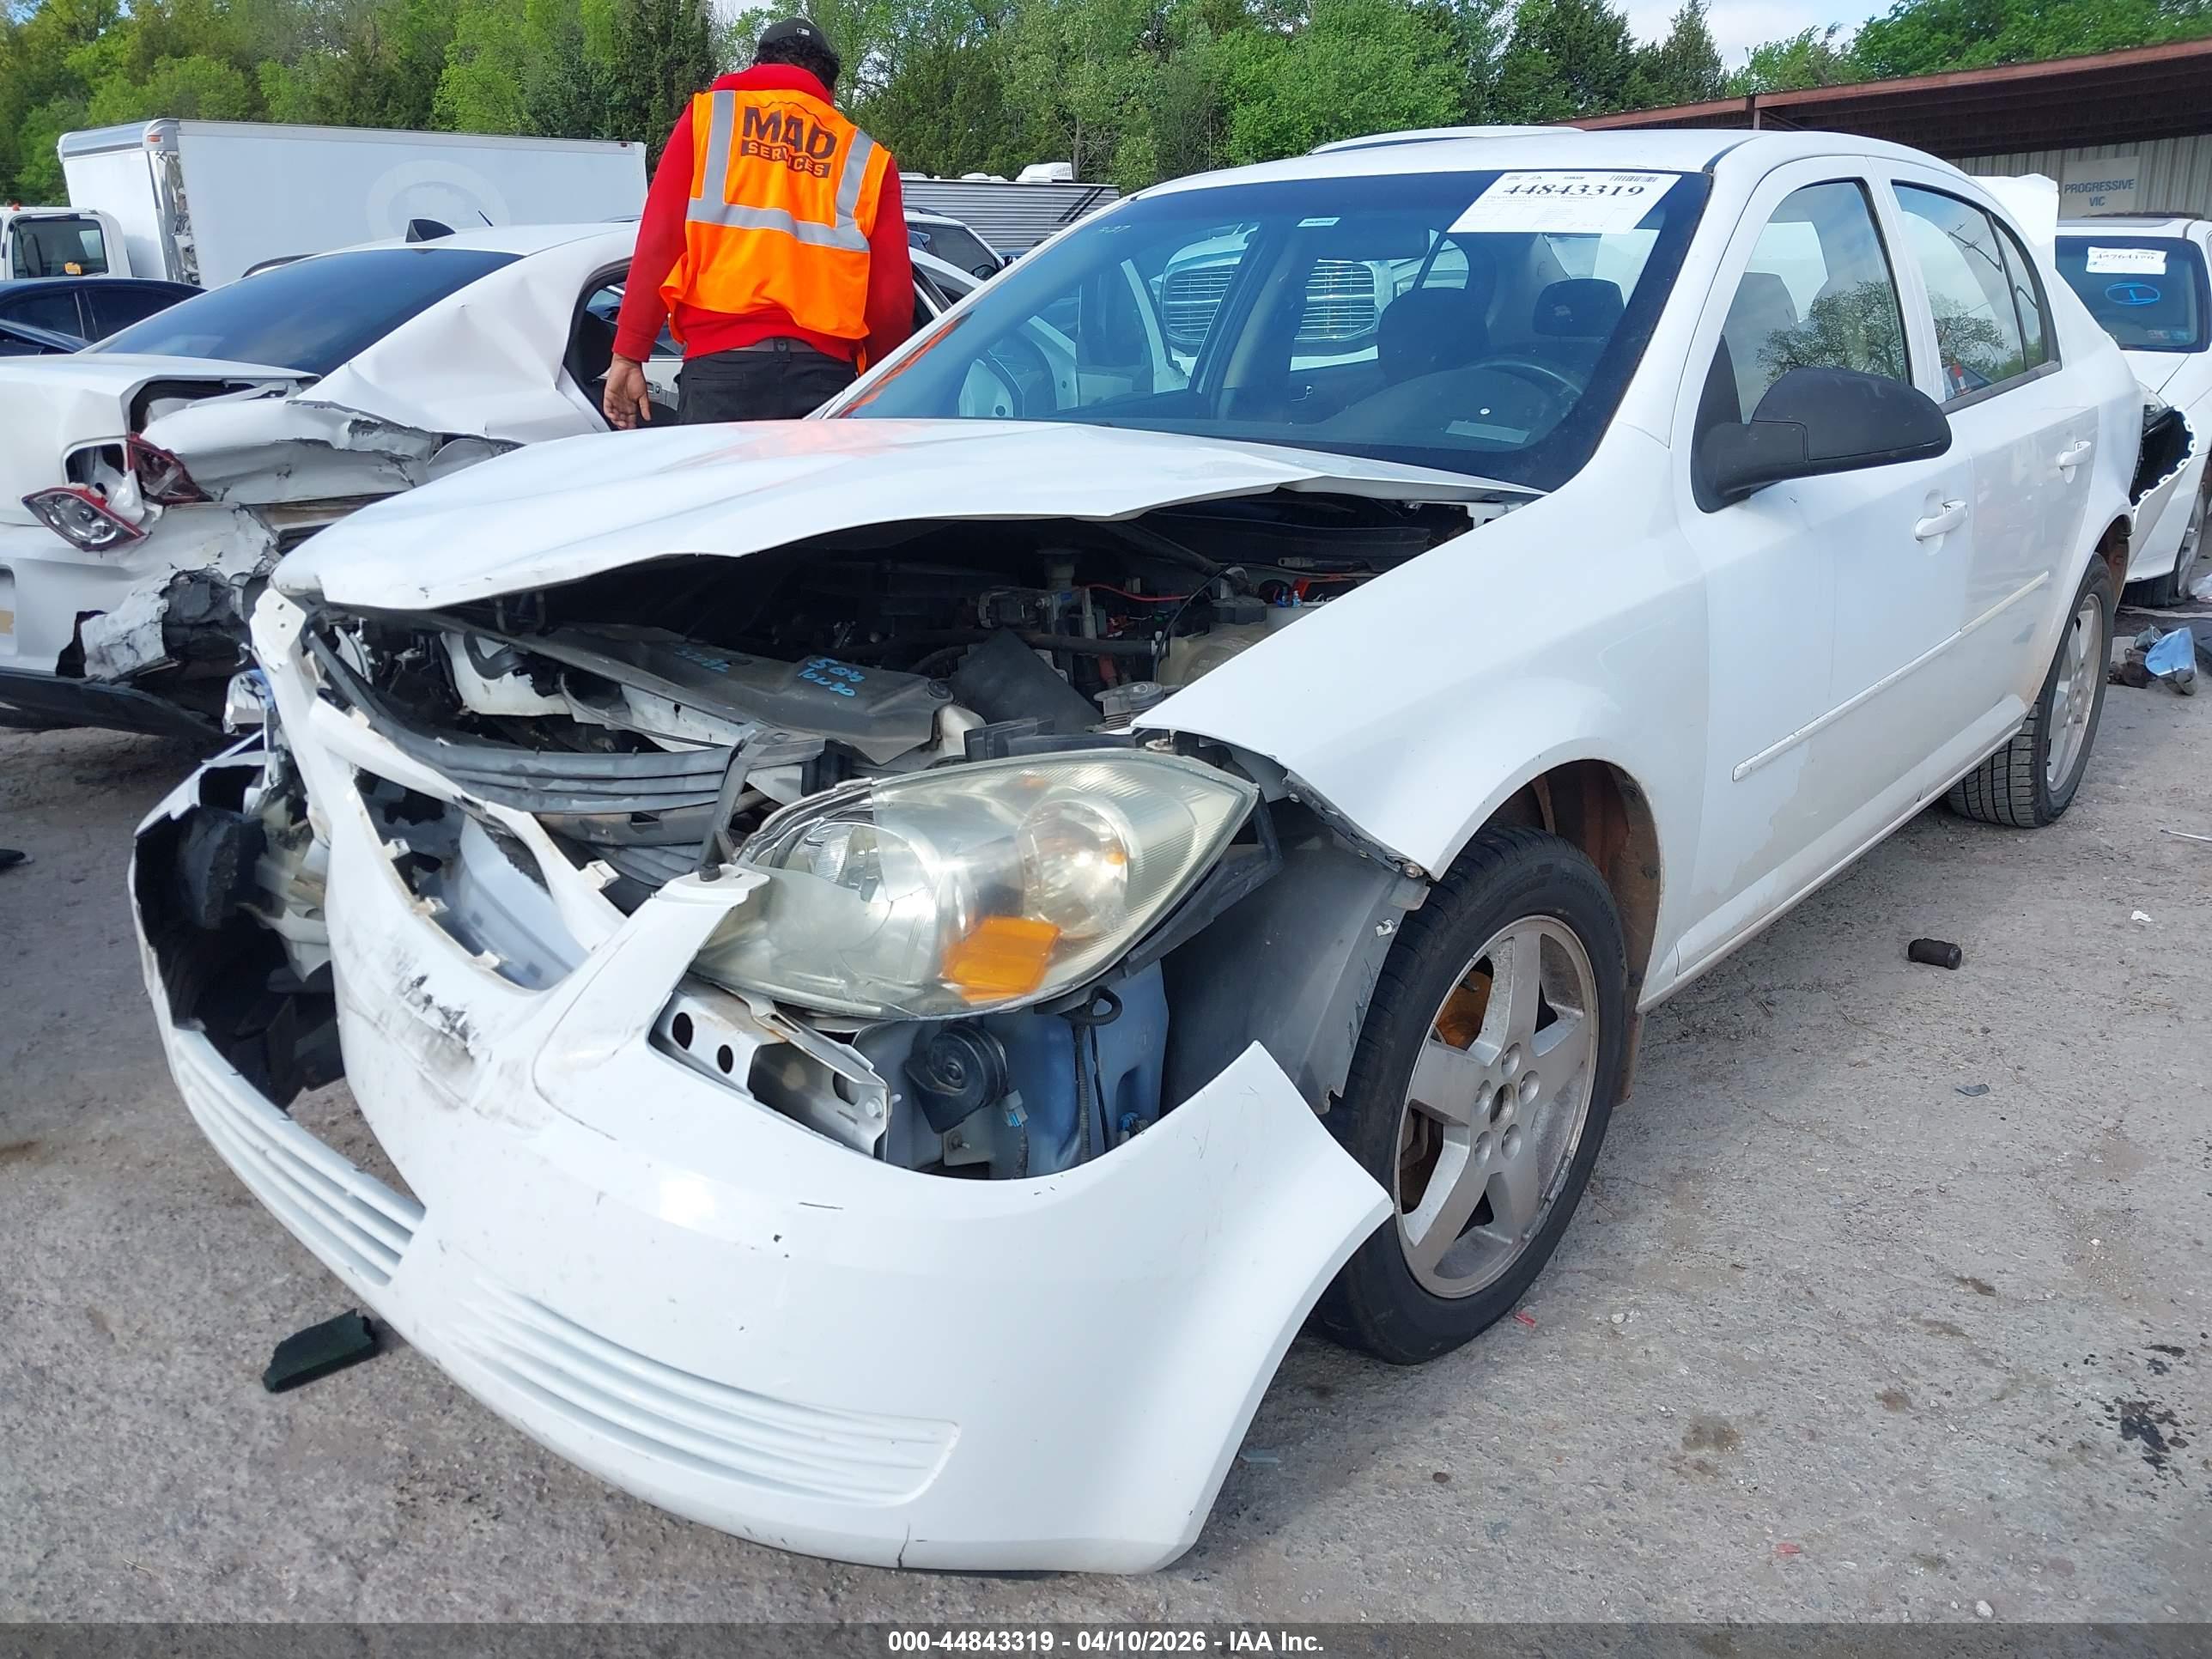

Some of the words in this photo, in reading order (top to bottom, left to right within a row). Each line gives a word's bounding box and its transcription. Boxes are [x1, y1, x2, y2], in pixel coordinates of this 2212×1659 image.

[743, 106, 837, 160] MAD
[747, 141, 824, 176] SERVICES
[1503, 184, 1645, 197] 44843319
[2064, 179, 2135, 194] PROGRESSIVE
[2089, 196, 2106, 207] VIC
